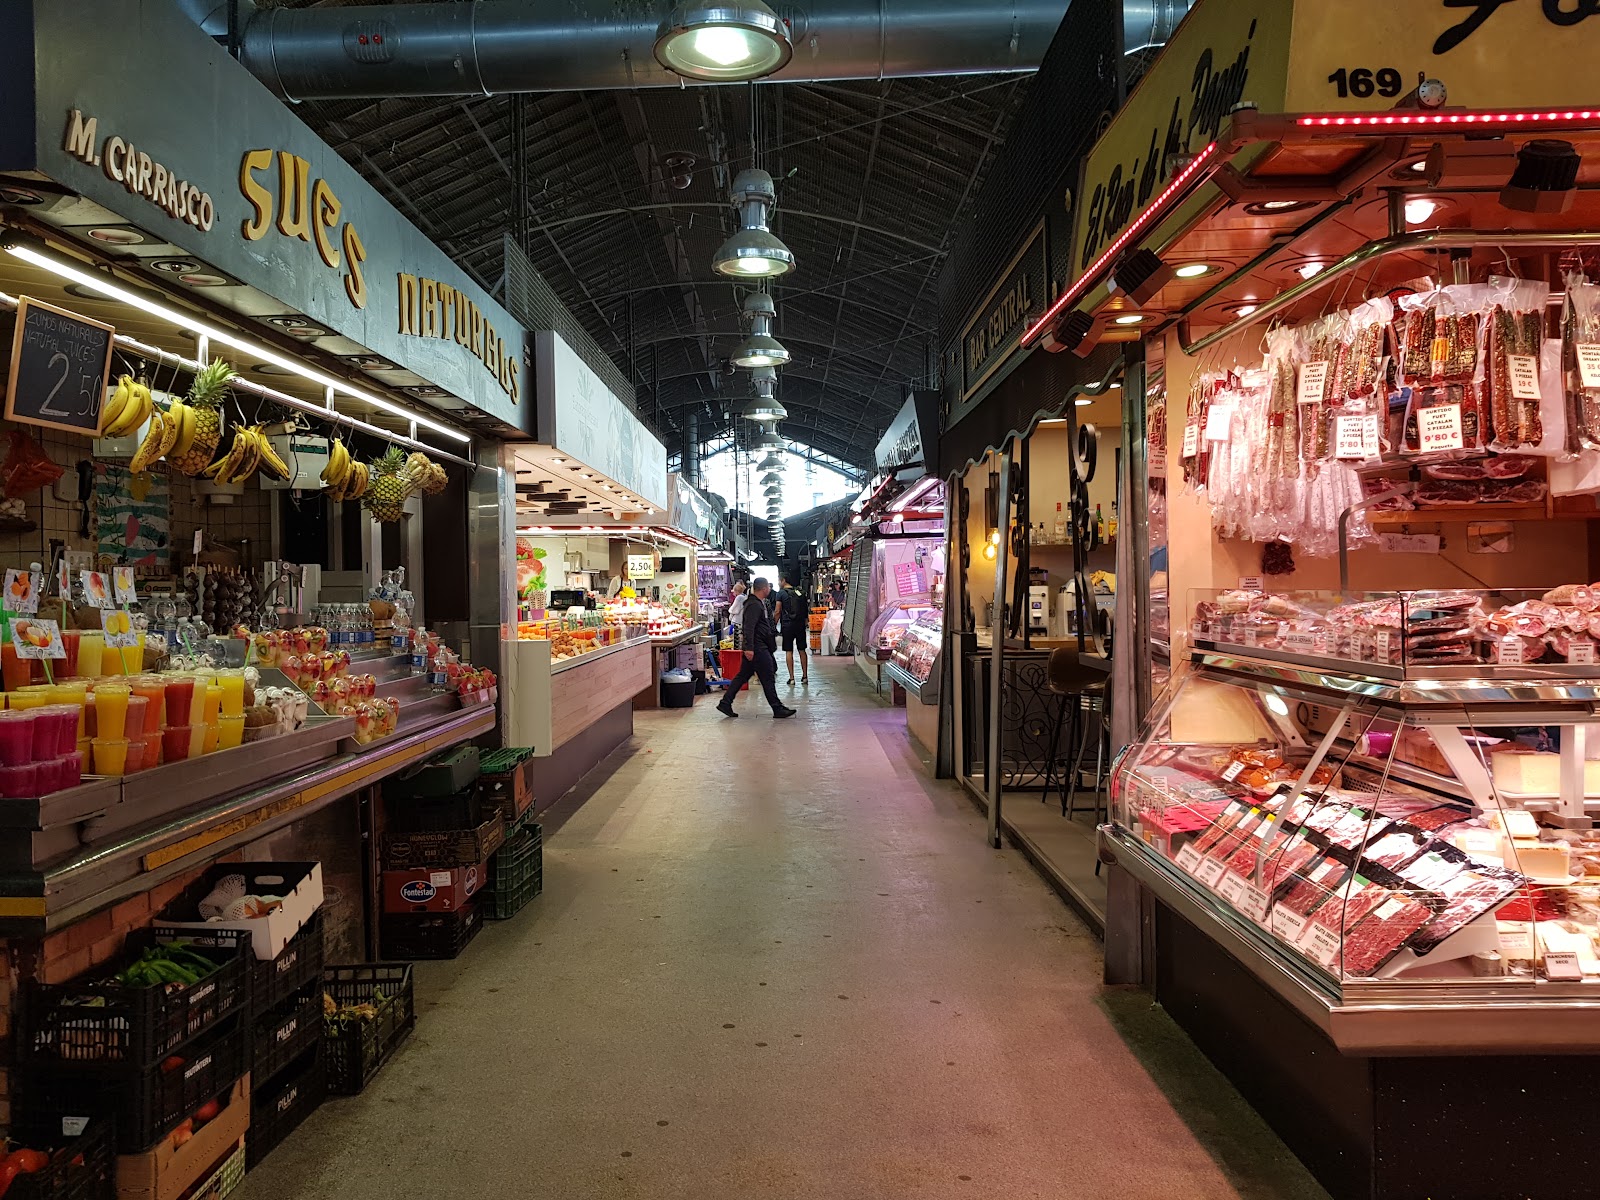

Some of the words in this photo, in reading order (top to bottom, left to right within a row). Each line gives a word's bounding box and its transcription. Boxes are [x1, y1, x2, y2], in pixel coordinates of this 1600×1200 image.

[1328, 68, 1402, 97] 169
[65, 110, 100, 166] M.
[103, 136, 214, 232] CARRASCO
[1138, 128, 1159, 209] de
[26, 312, 57, 331] ZUMOS
[58, 320, 105, 347] NATURALES
[970, 328, 986, 371] BAR
[988, 273, 1031, 350] CENTRAL
[24, 329, 61, 353] NATURAL
[64, 340, 97, 363] JUICES
[397, 272, 520, 405] NATURALS
[1425, 433, 1448, 442] 9'80
[403, 888, 434, 897] Fontestad
[1275, 909, 1287, 919] PALETA
[1286, 915, 1301, 928] IBERICA
[1314, 924, 1326, 935] PALETA
[1325, 931, 1340, 944] IBERICA
[1315, 934, 1329, 946] BELLOTA
[276, 951, 297, 972] PILLIN
[277, 1018, 297, 1042] PILLIN
[277, 1087, 297, 1112] PILLIN
